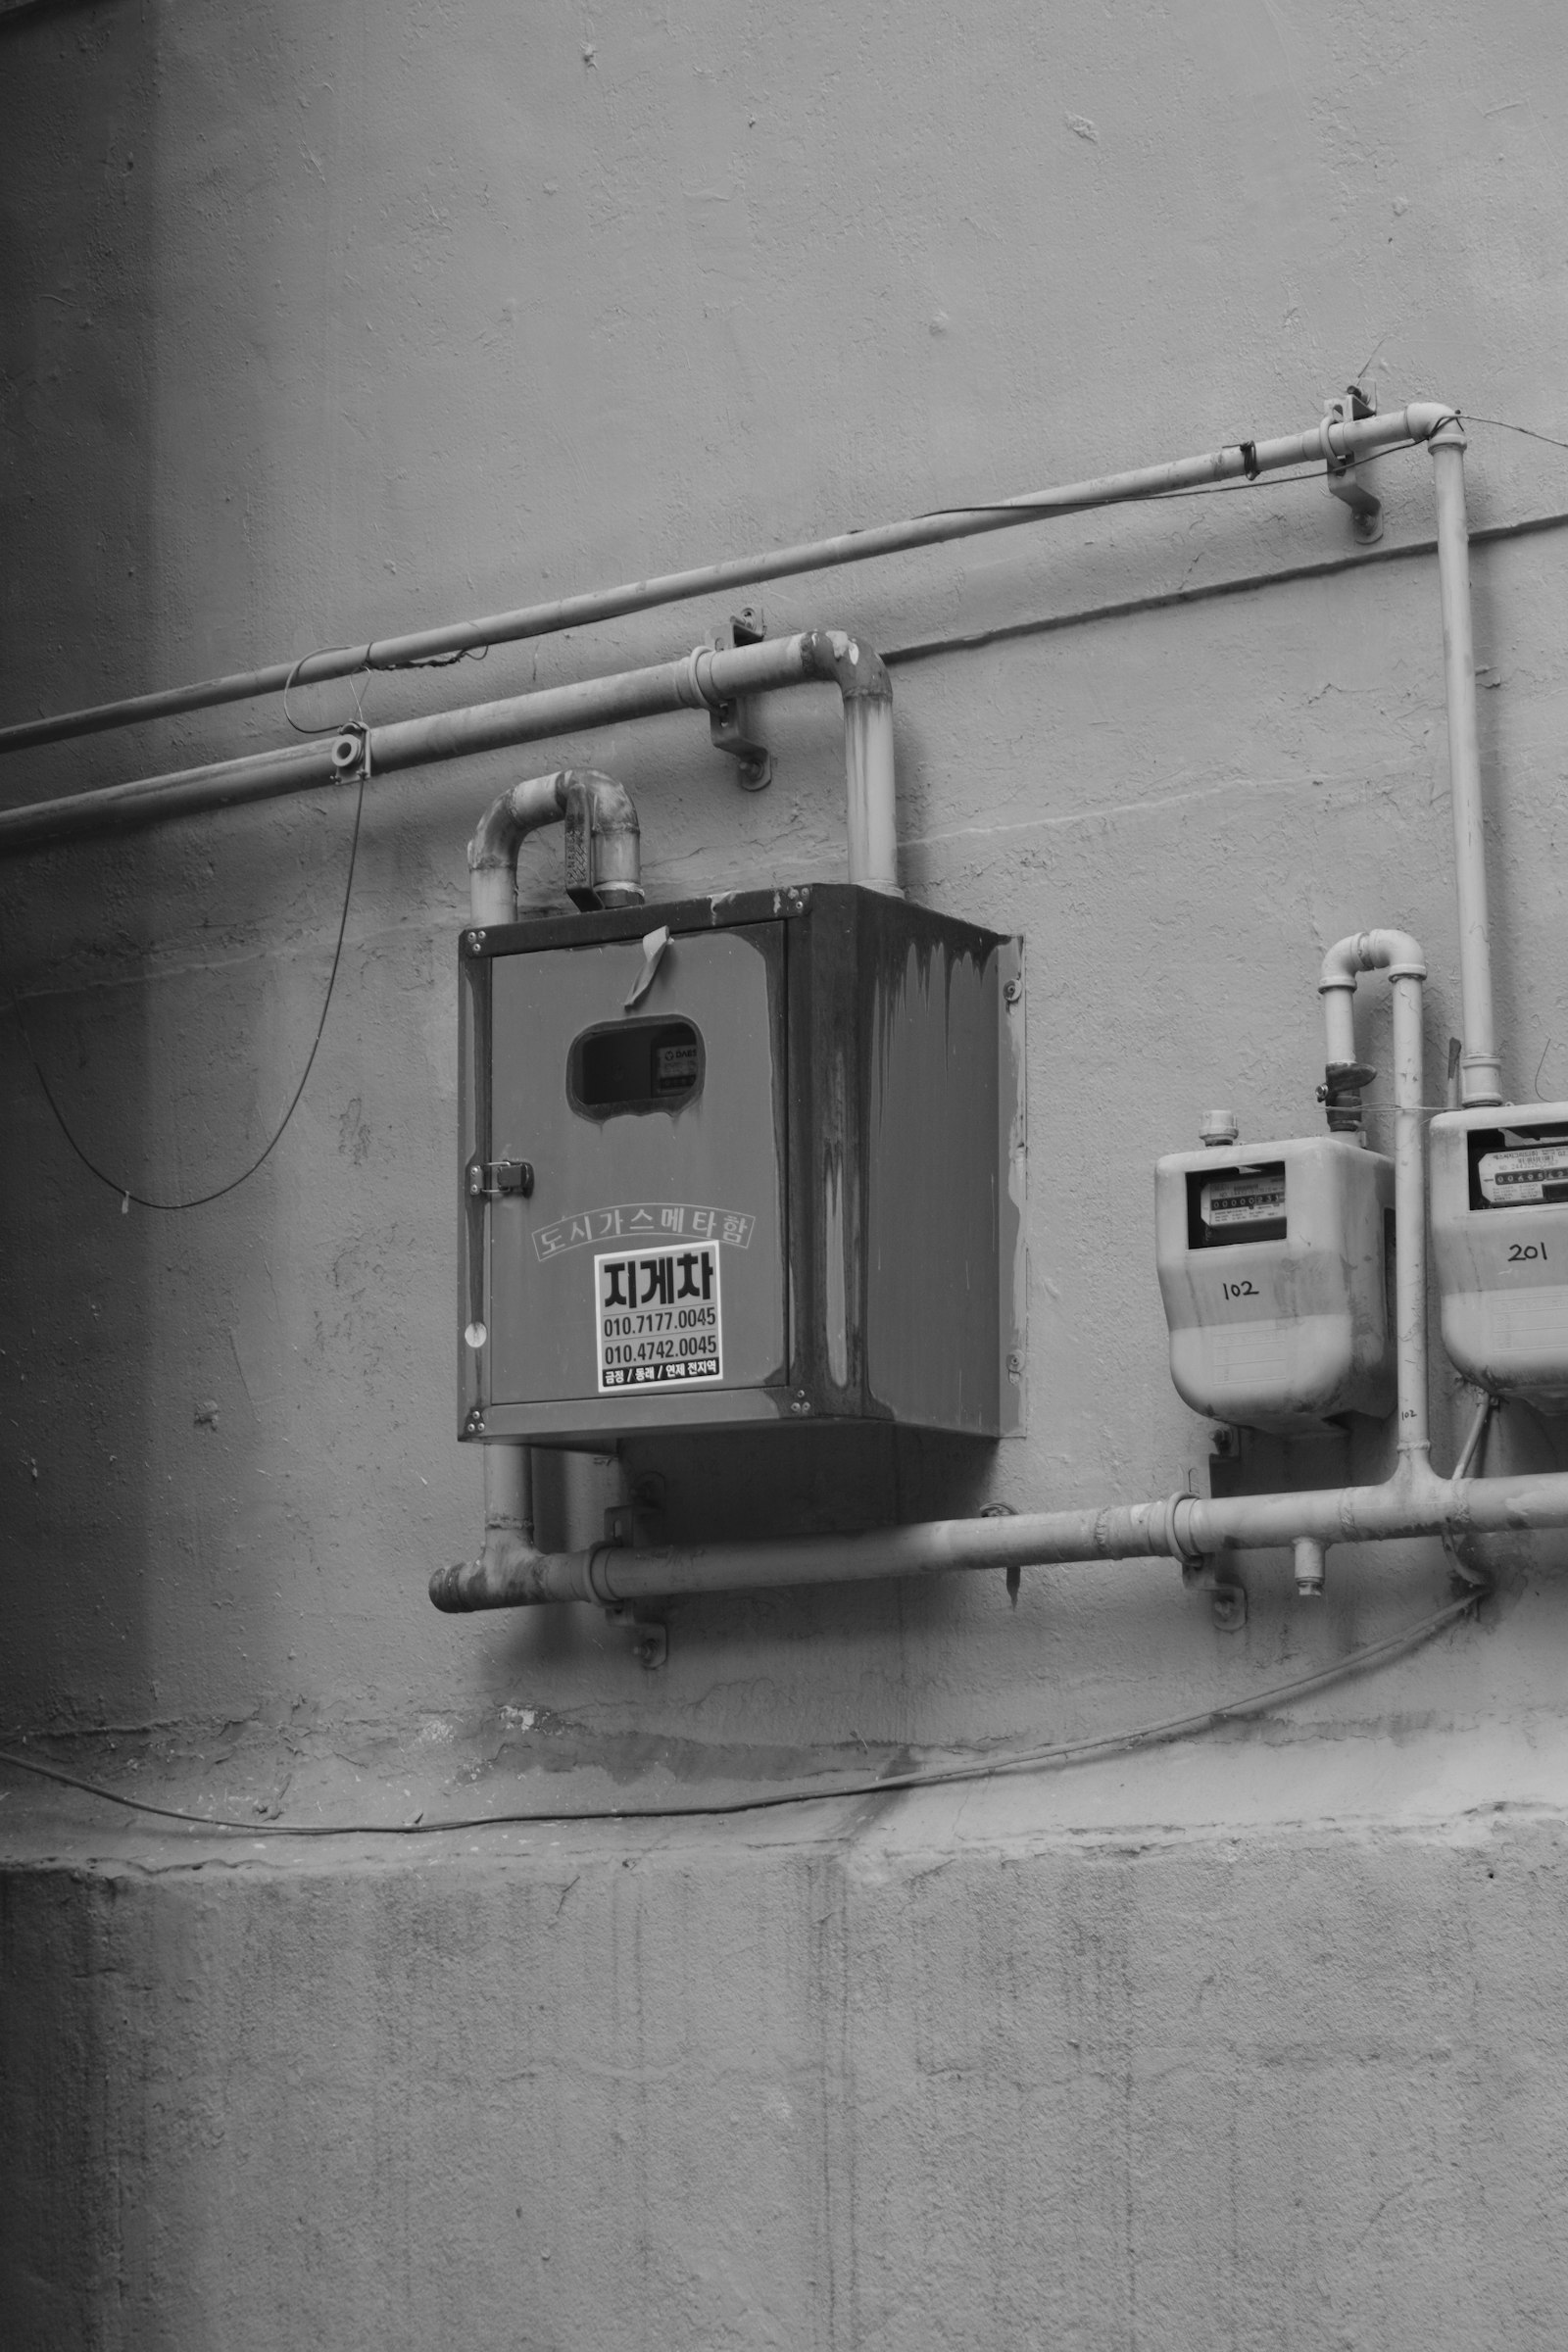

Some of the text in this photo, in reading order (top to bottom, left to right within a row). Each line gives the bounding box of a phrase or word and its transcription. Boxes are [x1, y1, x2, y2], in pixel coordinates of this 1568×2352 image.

[541, 1207, 748, 1255] 도시가스메타함
[1507, 1242, 1547, 1261] 201
[604, 1251, 713, 1308] 지게차
[1223, 1281, 1259, 1300] 102
[604, 1306, 716, 1337] 010.7177.0045
[605, 1335, 717, 1364] 010.4742.0045
[605, 1370, 624, 1384] 금정
[635, 1366, 655, 1381] 동래
[665, 1363, 685, 1378] 연제
[687, 1359, 716, 1375] 전지역
[1401, 1409, 1417, 1421] 102
